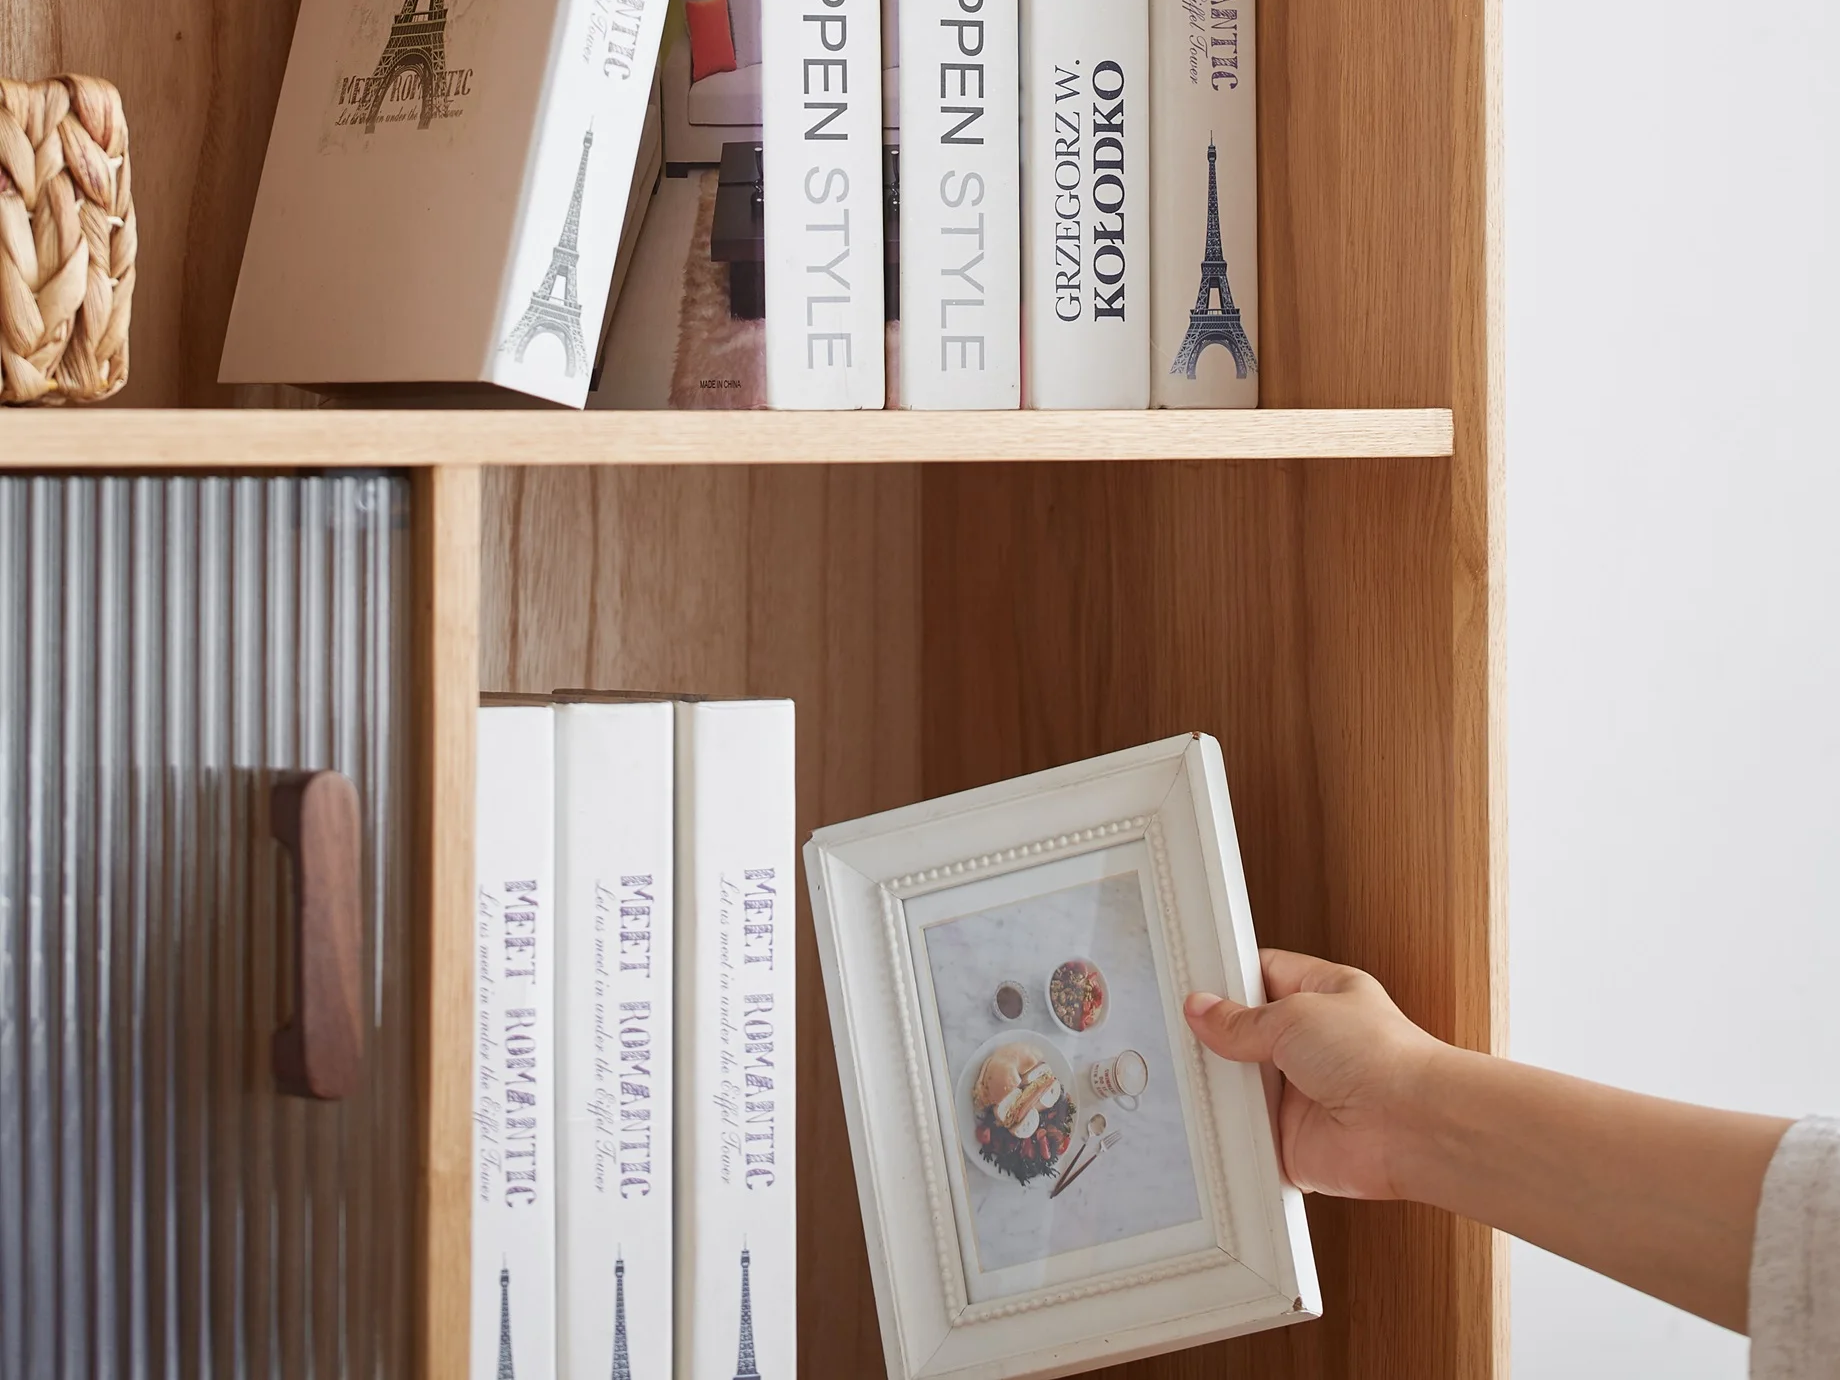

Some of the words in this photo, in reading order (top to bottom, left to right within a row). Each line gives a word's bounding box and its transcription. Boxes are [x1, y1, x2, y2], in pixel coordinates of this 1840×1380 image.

[582, 12, 608, 65] Tower
[1188, 32, 1209, 85] Tower
[390, 68, 474, 102] ROMNTIC
[1054, 59, 1081, 105] W.
[1091, 59, 1126, 323] KOŁODKO
[1054, 111, 1082, 322] GRZEGORZ
[805, 166, 852, 370] STYLE
[939, 170, 985, 372] STYLE
[700, 380, 716, 389] MADE
[717, 380, 723, 389] IN
[724, 380, 741, 389] CHINA
[595, 878, 616, 912] Let
[719, 872, 740, 906] Let
[504, 880, 539, 985] MEET
[595, 916, 605, 932] us
[619, 874, 654, 978] MEET
[720, 909, 729, 925] us
[743, 867, 777, 971] MEET
[595, 938, 609, 976] meet
[720, 932, 734, 969] meet
[595, 980, 611, 997] in
[720, 973, 735, 991] in
[595, 1003, 614, 1052] under
[720, 996, 738, 1045] under
[595, 1057, 614, 1082] the
[720, 1050, 738, 1074] the
[504, 1008, 538, 1208] ROMANTIC
[586, 1087, 617, 1136] Eiffel
[619, 1001, 652, 1199] ROMANTIC
[712, 1080, 741, 1127] Eiffel
[743, 993, 775, 1191] ROMANTIC
[595, 1139, 617, 1193] Tower
[720, 1131, 742, 1184] Tower
